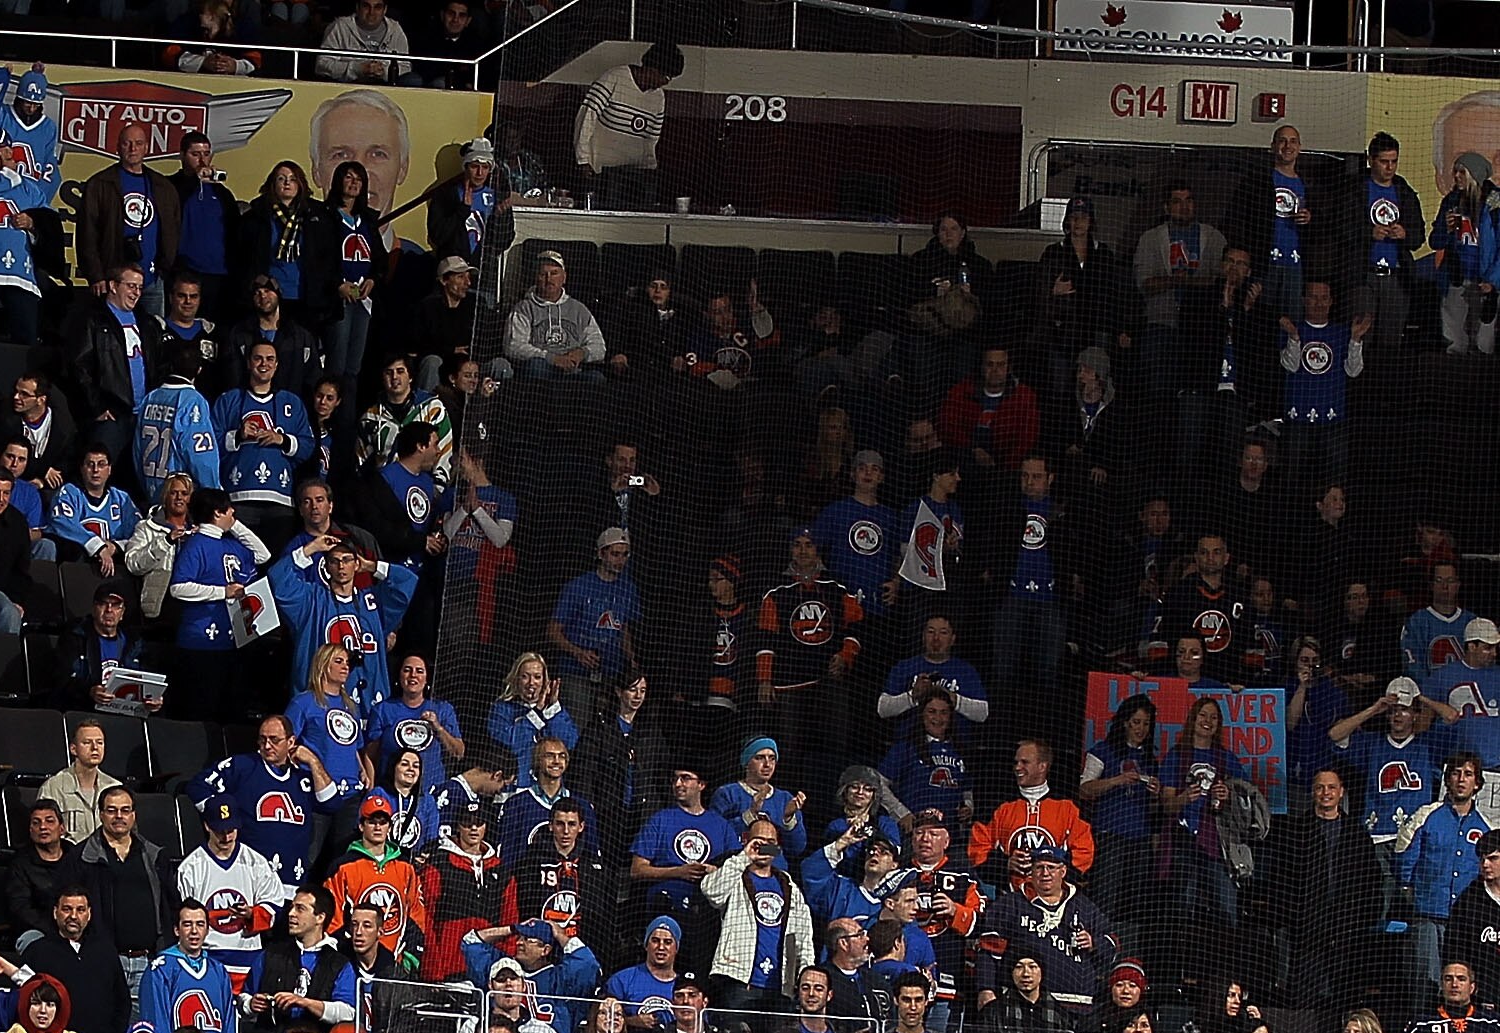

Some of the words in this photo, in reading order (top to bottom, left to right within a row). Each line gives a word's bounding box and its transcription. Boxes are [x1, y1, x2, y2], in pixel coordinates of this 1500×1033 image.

[725, 95, 787, 122] 208
[1111, 84, 1167, 118] G14
[1191, 83, 1230, 119] EXIT
[80, 102, 111, 121] NY
[111, 106, 184, 127] AUTO
[284, 404, 292, 417] C
[141, 424, 173, 479] 21
[192, 432, 214, 452] 21
[110, 503, 121, 521] C
[364, 593, 378, 611] C
[299, 777, 312, 793] C
[943, 875, 955, 890] C
